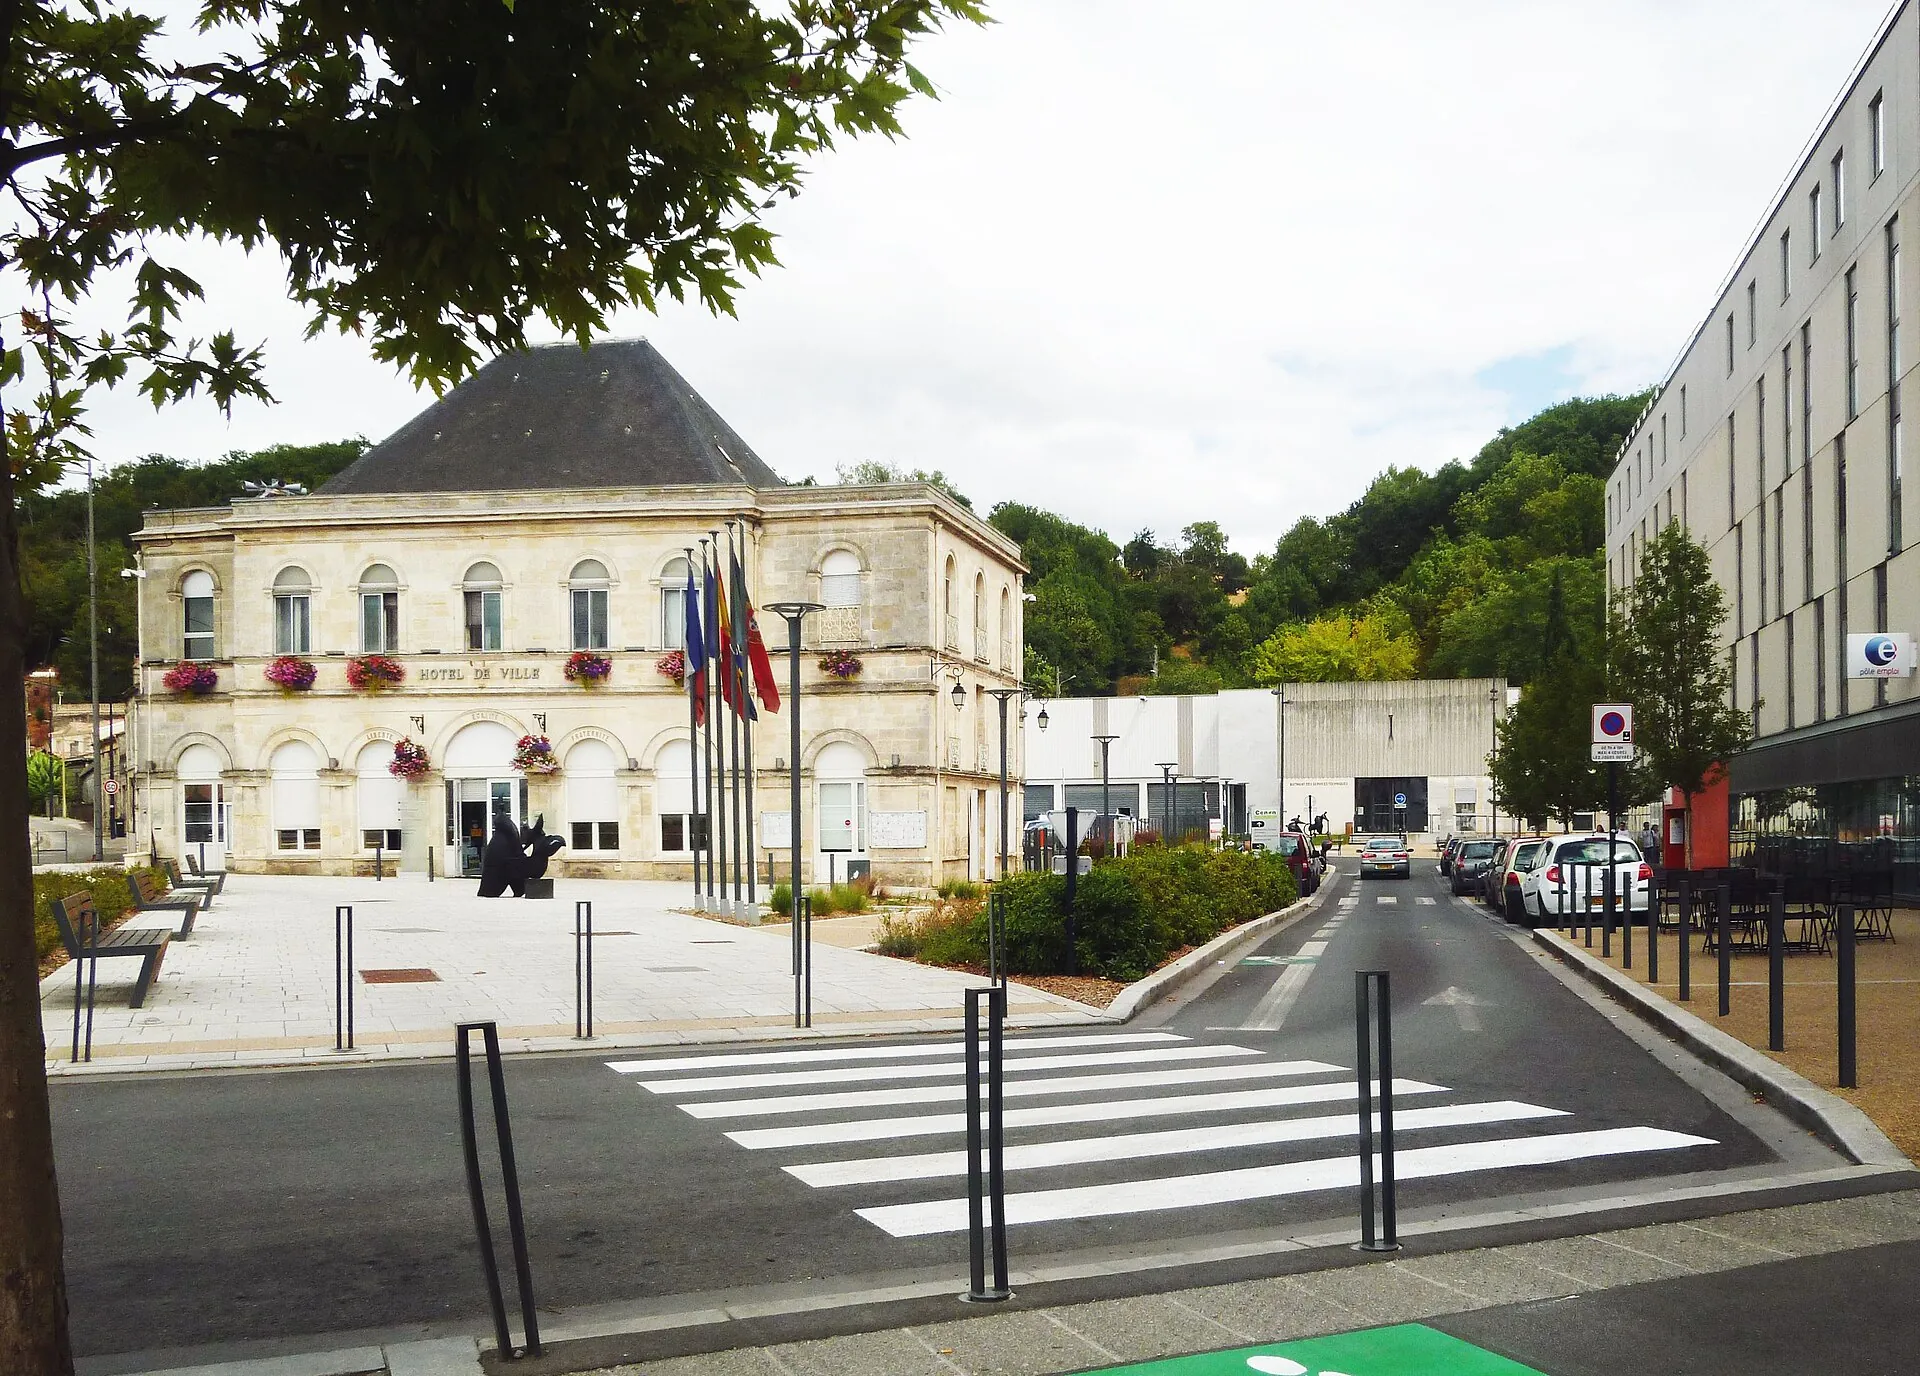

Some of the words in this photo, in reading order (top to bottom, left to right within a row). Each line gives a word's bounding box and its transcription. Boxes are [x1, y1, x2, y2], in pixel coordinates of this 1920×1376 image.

[420, 669, 464, 680] HOTEL
[474, 669, 490, 680] DE
[500, 668, 540, 680] VILLE
[1877, 668, 1899, 676] emploi
